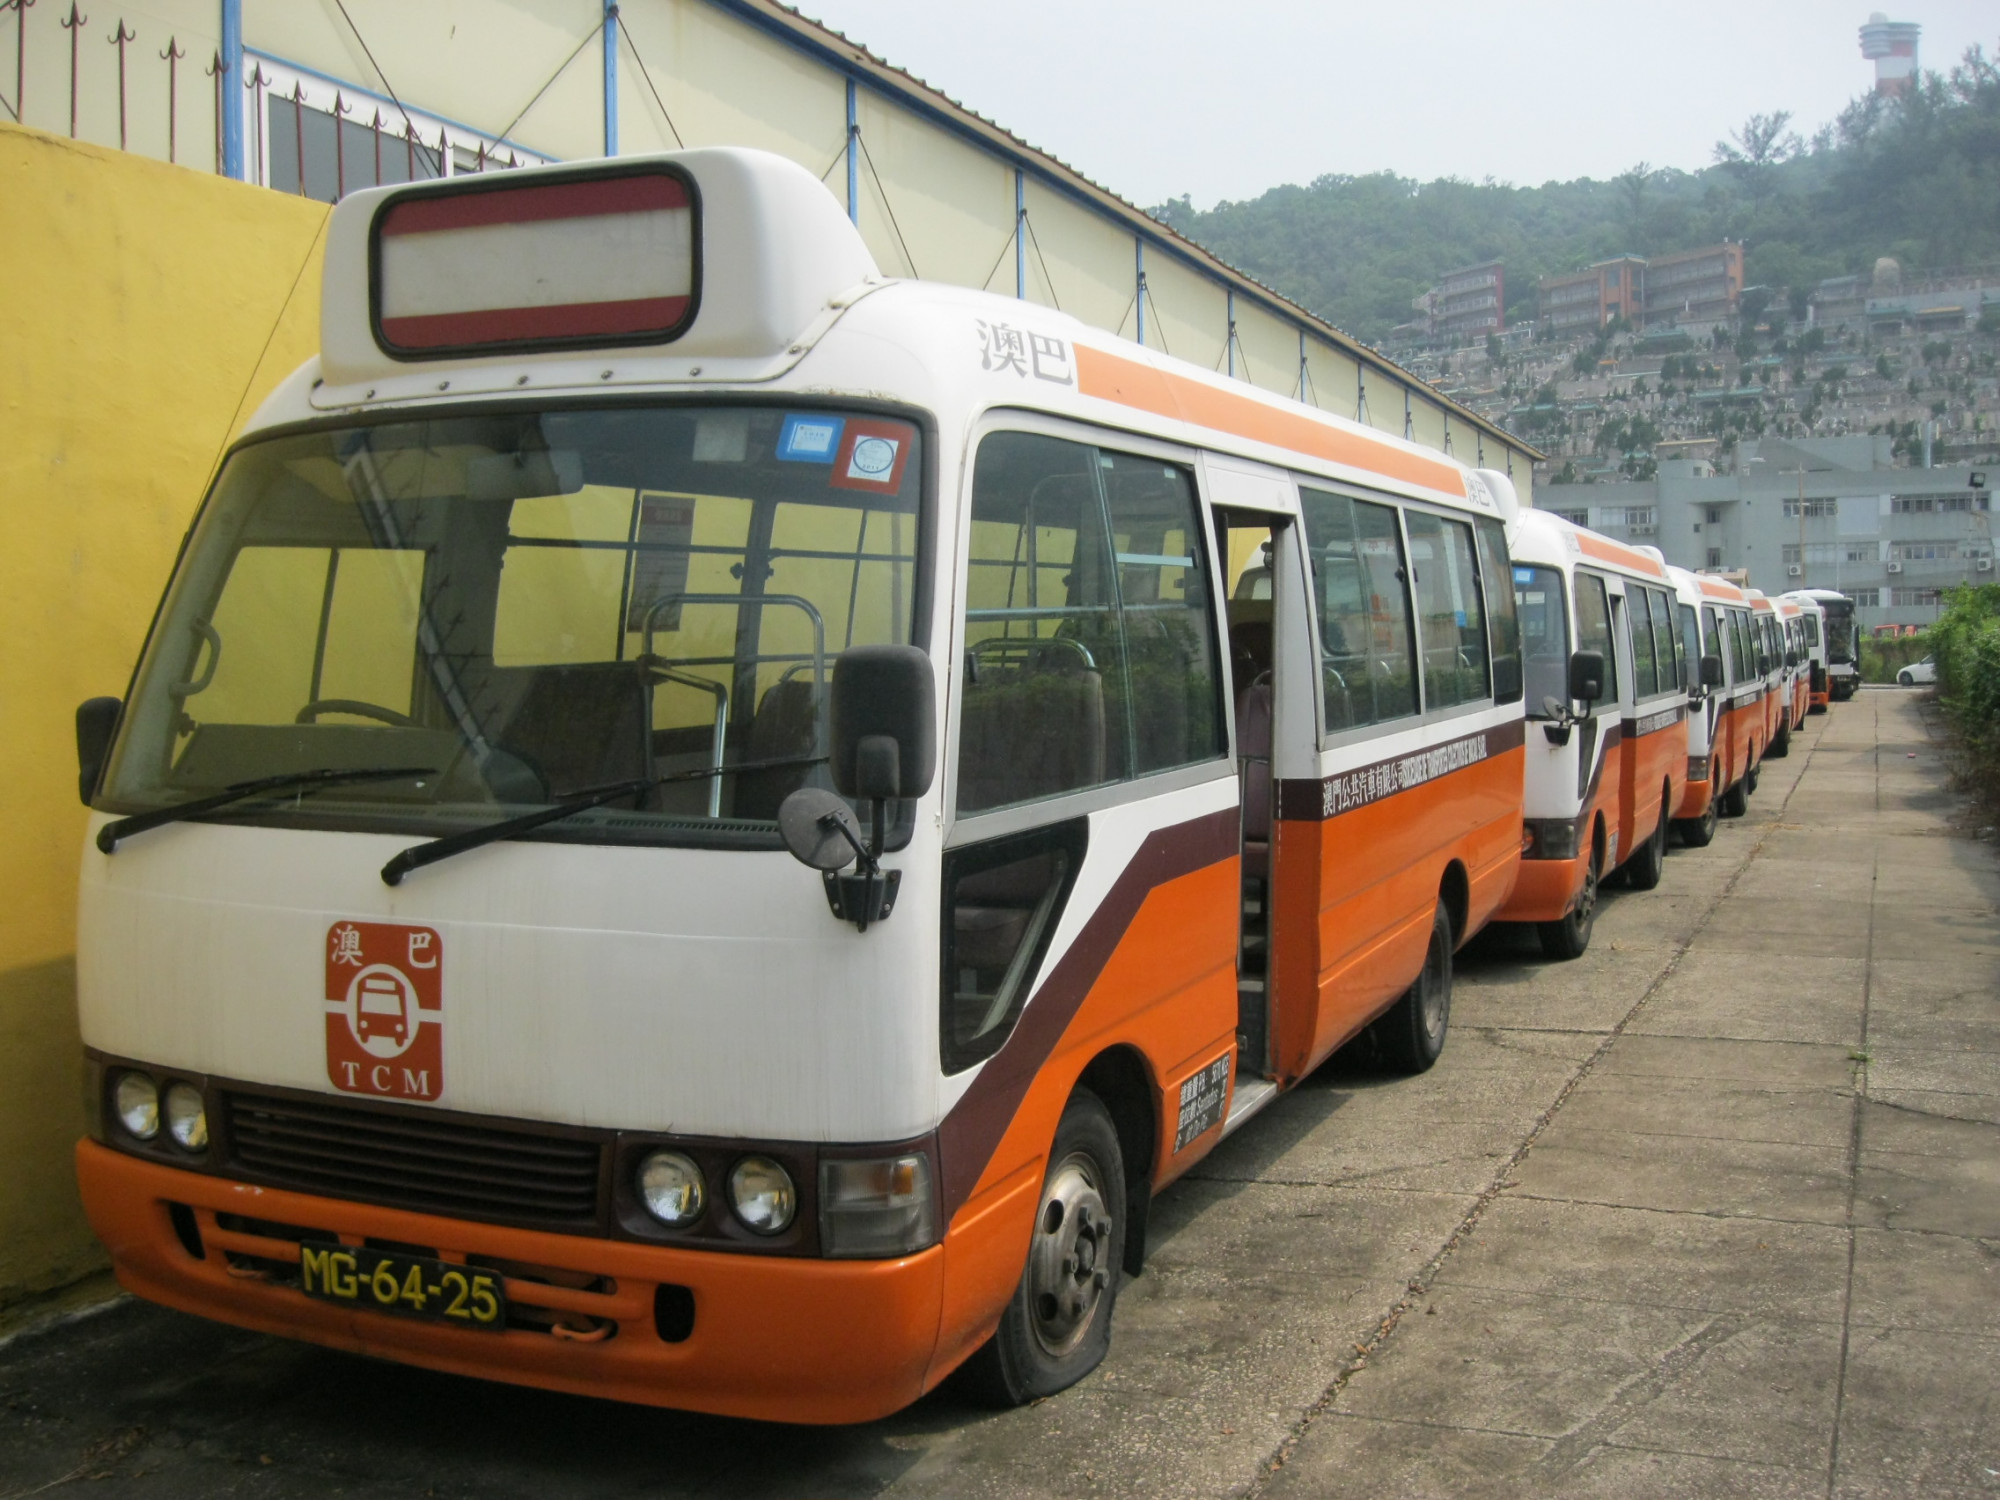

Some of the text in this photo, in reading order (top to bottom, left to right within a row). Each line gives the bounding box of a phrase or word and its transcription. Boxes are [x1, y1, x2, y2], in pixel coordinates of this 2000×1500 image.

[974, 318, 1073, 386] 澳巴
[331, 924, 437, 969] 澳巴
[302, 1247, 498, 1322] MG-64-25
